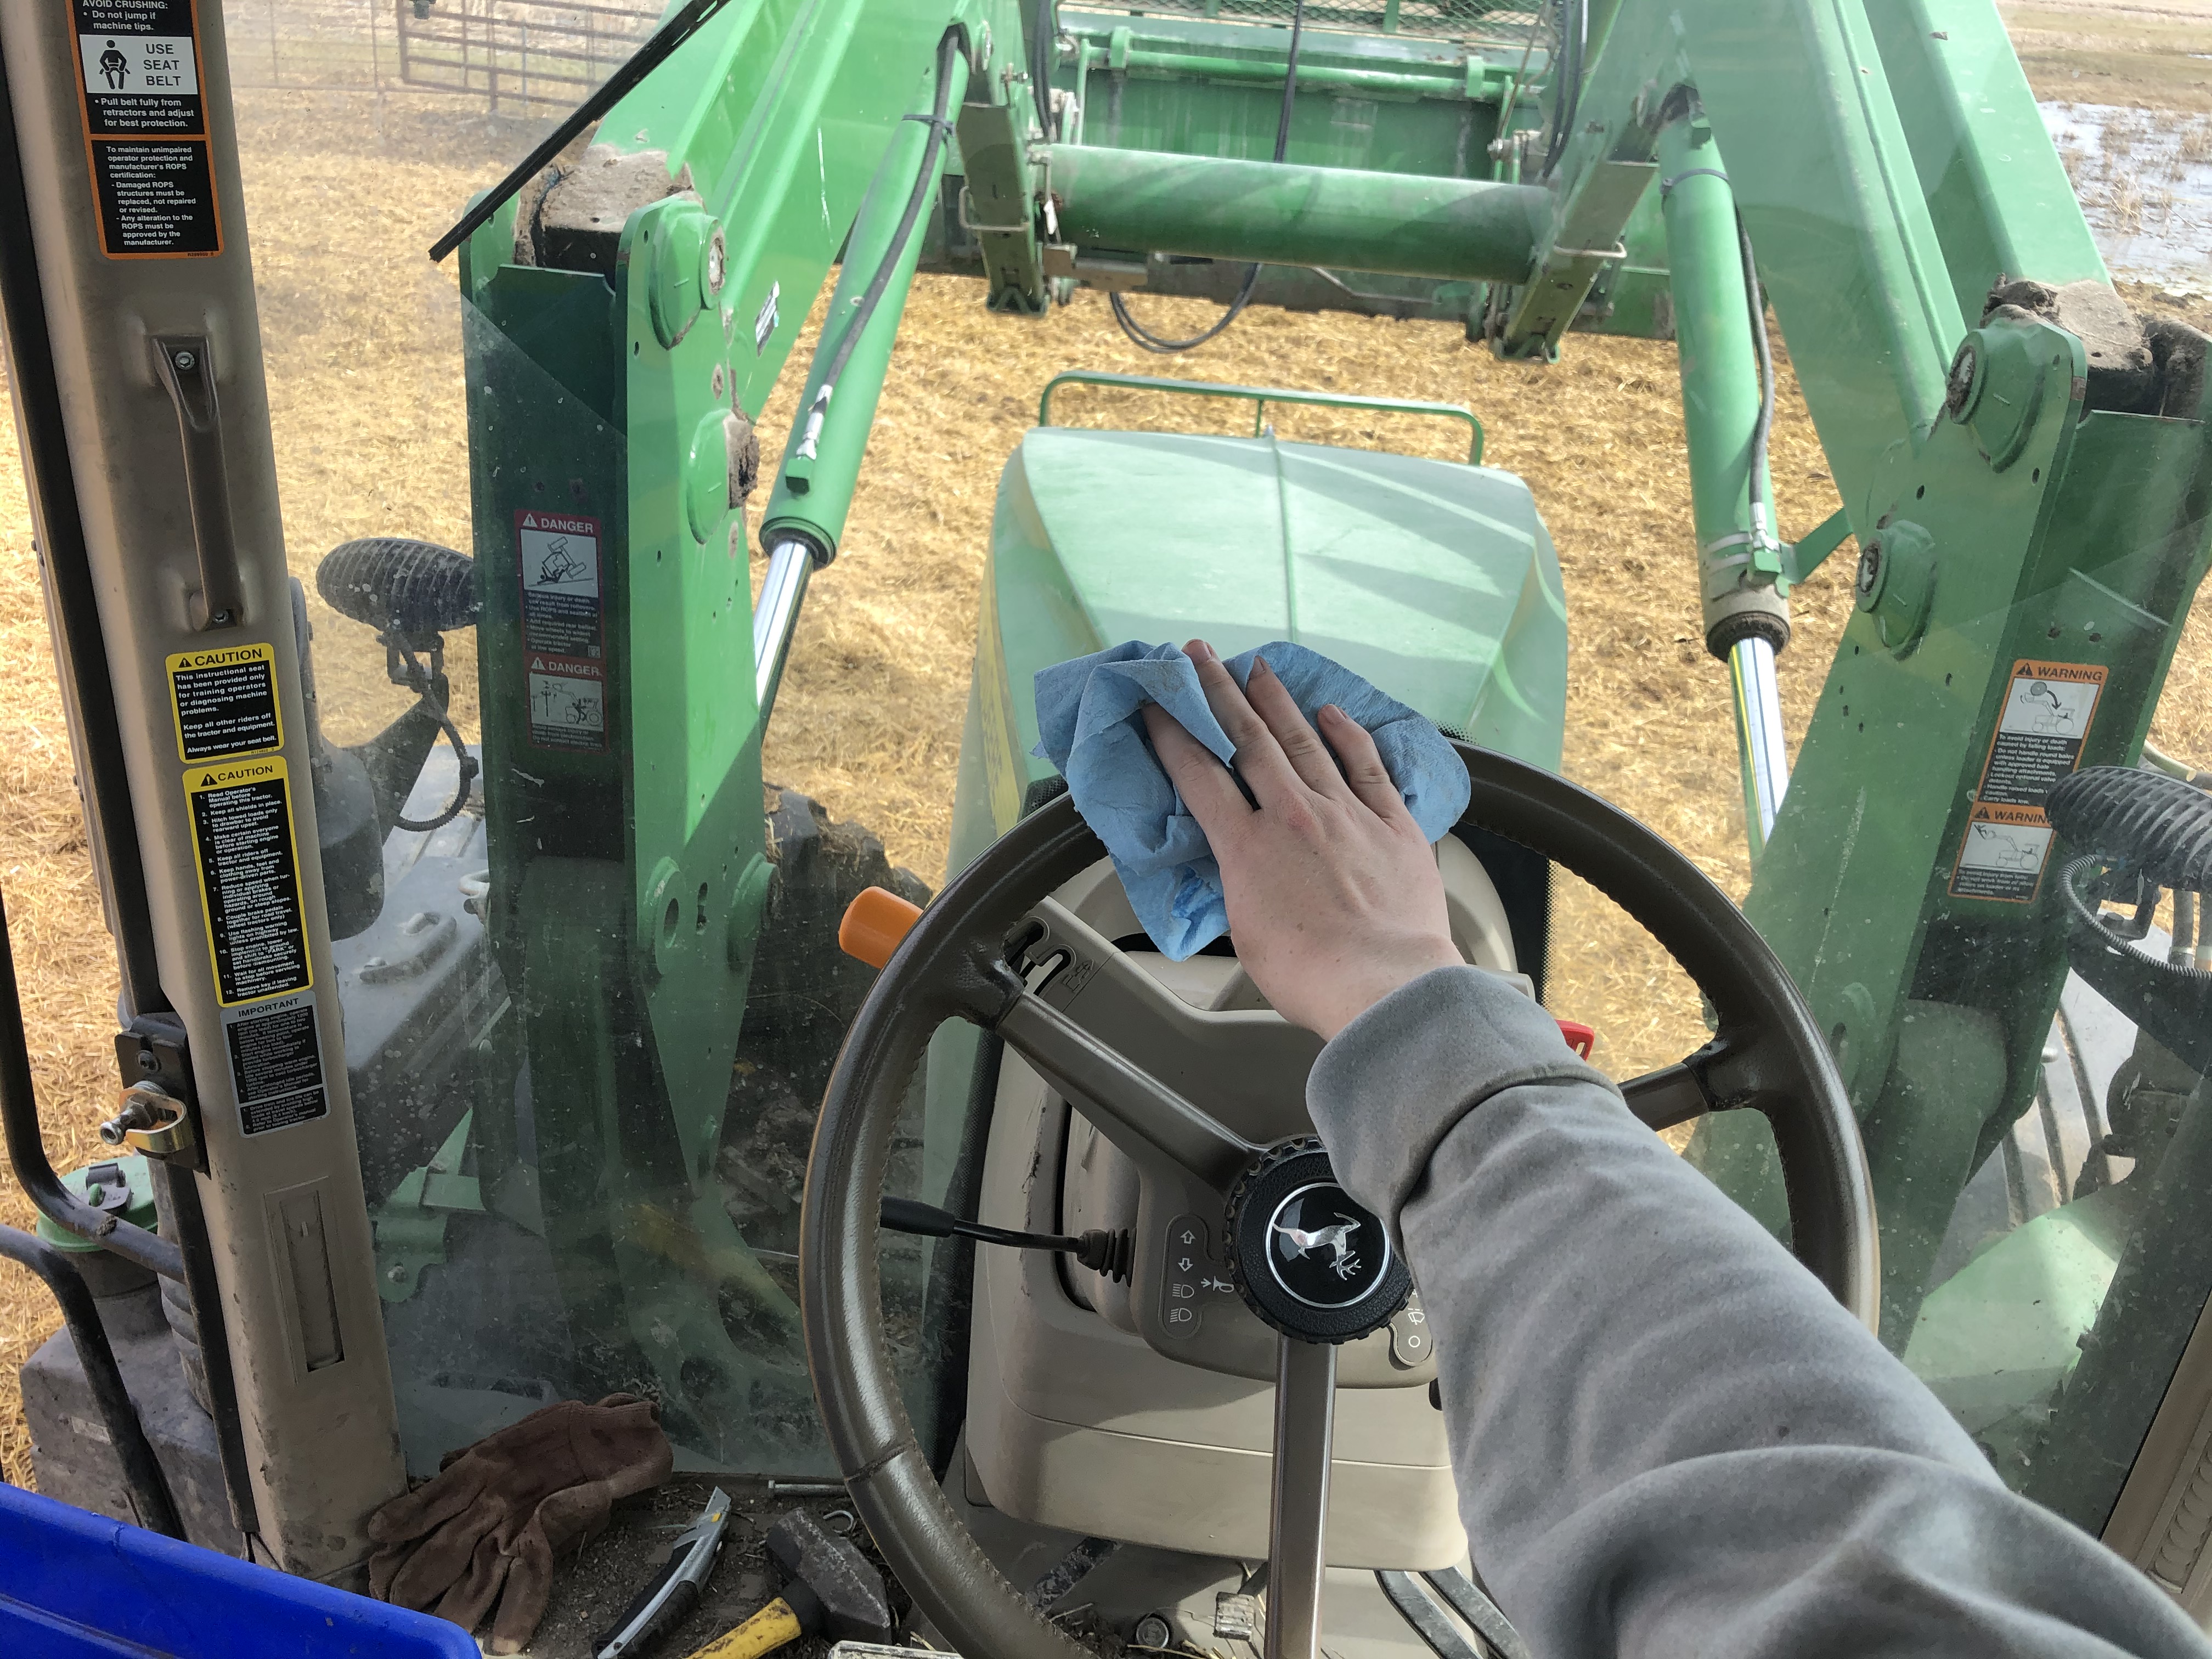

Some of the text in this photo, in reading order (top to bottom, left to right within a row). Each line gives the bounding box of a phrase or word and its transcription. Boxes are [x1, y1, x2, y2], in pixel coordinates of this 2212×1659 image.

[115, 0, 168, 9] CRUSHING:
[92, 10, 105, 18] Do
[125, 11, 148, 21] jump
[93, 21, 154, 31] machine tips.
[145, 43, 174, 54] USE
[143, 59, 179, 70] SEAT
[145, 75, 181, 86] BELT
[139, 98, 159, 108] fully
[167, 109, 194, 118] adjust
[140, 119, 188, 128] protection.
[541, 518, 593, 533] DANGER
[194, 648, 262, 666] CAUTION
[195, 667, 246, 679] instructional
[549, 661, 600, 676] DANGER
[2038, 666, 2102, 681] WARNING
[214, 675, 247, 686] provided
[193, 688, 225, 697] training
[227, 682, 266, 692] operators
[190, 696, 234, 706] diagnosing
[235, 691, 267, 699] machine
[181, 707, 219, 716] problems.
[237, 721, 275, 731] equipment.
[230, 740, 246, 748] your
[218, 765, 273, 781] CAUTION
[209, 800, 238, 808] operating
[1994, 810, 2048, 823] WARNIN
[213, 824, 239, 833] rearward
[252, 825, 279, 833] everyone
[238, 997, 298, 1017] IMPORTANT
